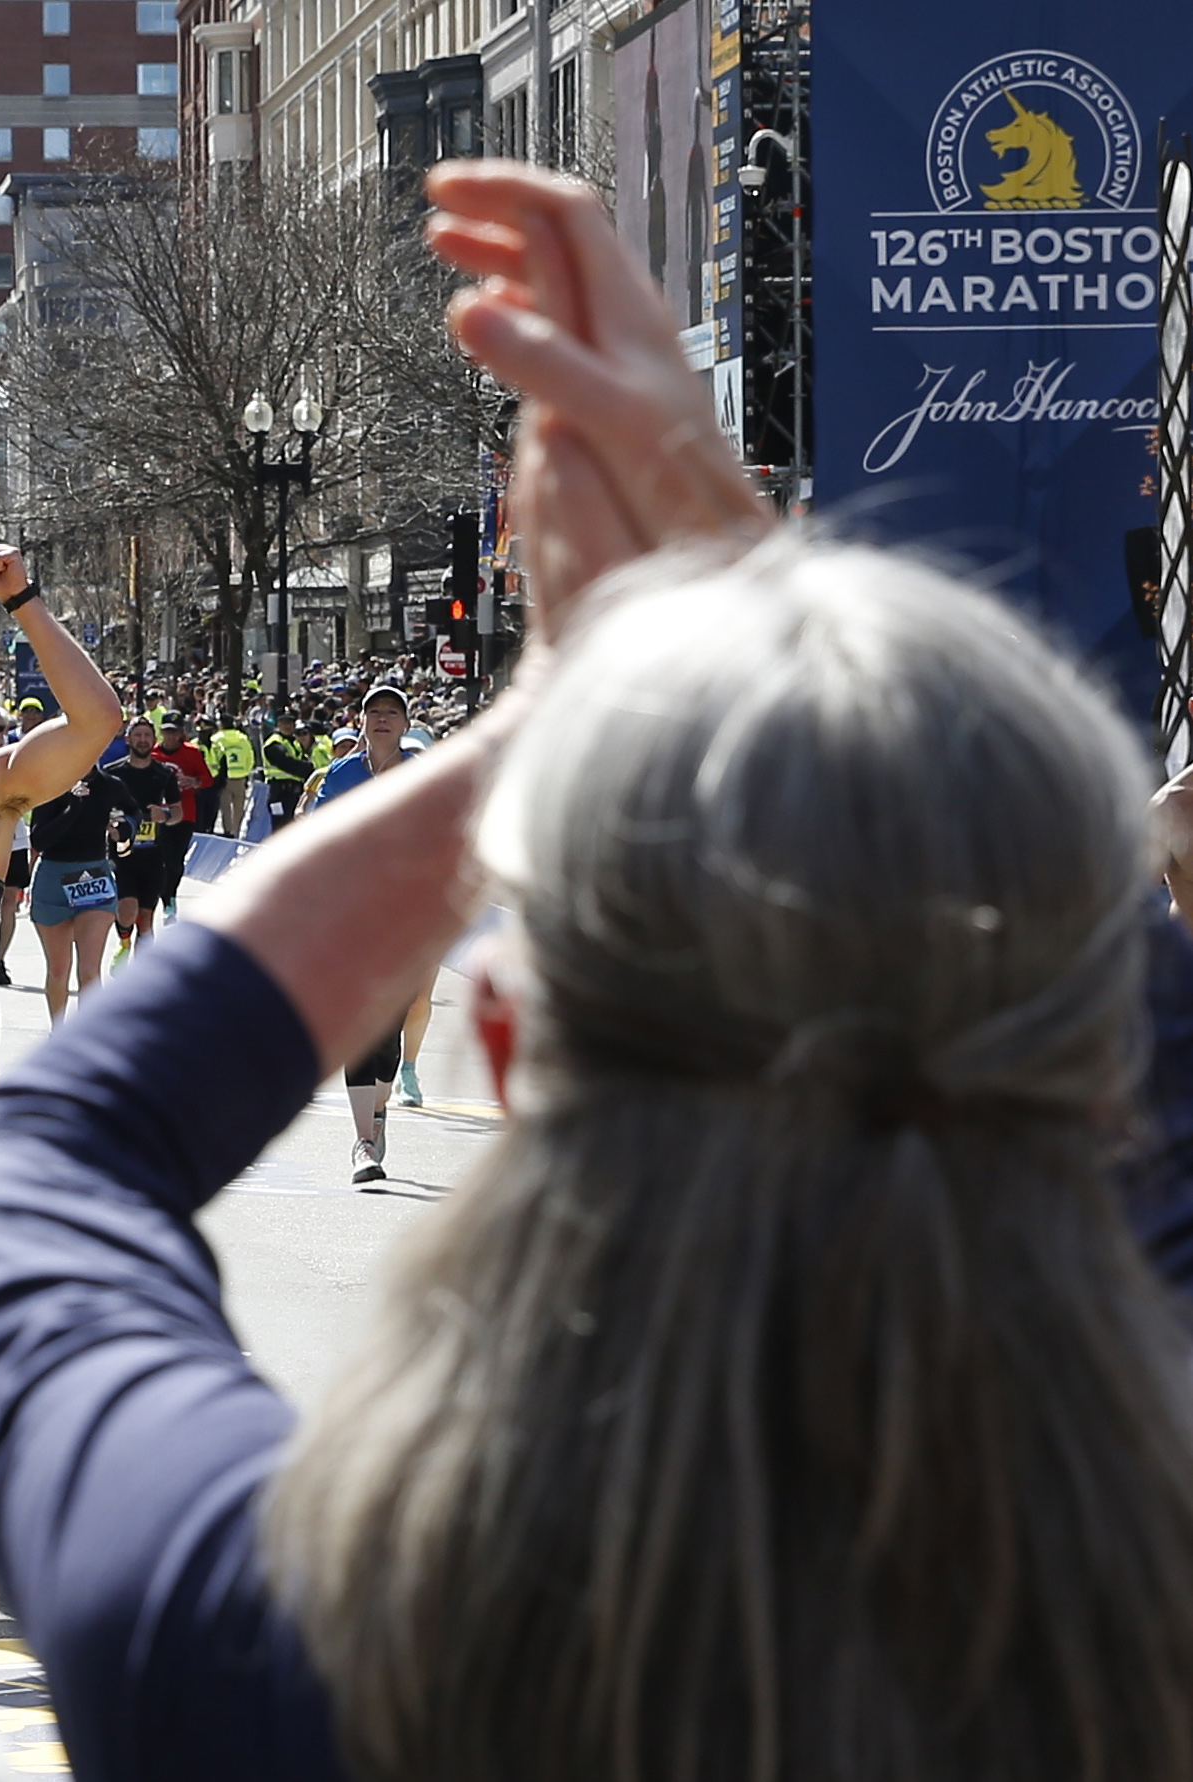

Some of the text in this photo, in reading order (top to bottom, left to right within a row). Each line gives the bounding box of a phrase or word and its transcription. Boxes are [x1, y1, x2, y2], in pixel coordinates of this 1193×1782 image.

[937, 59, 1133, 202] BOSTON ATHLETIC ASSOCIATION
[870, 226, 1160, 267] 126TH BOSTO
[871, 272, 1157, 314] MARATHO
[863, 362, 999, 474] John
[67, 879, 109, 900] 20252
